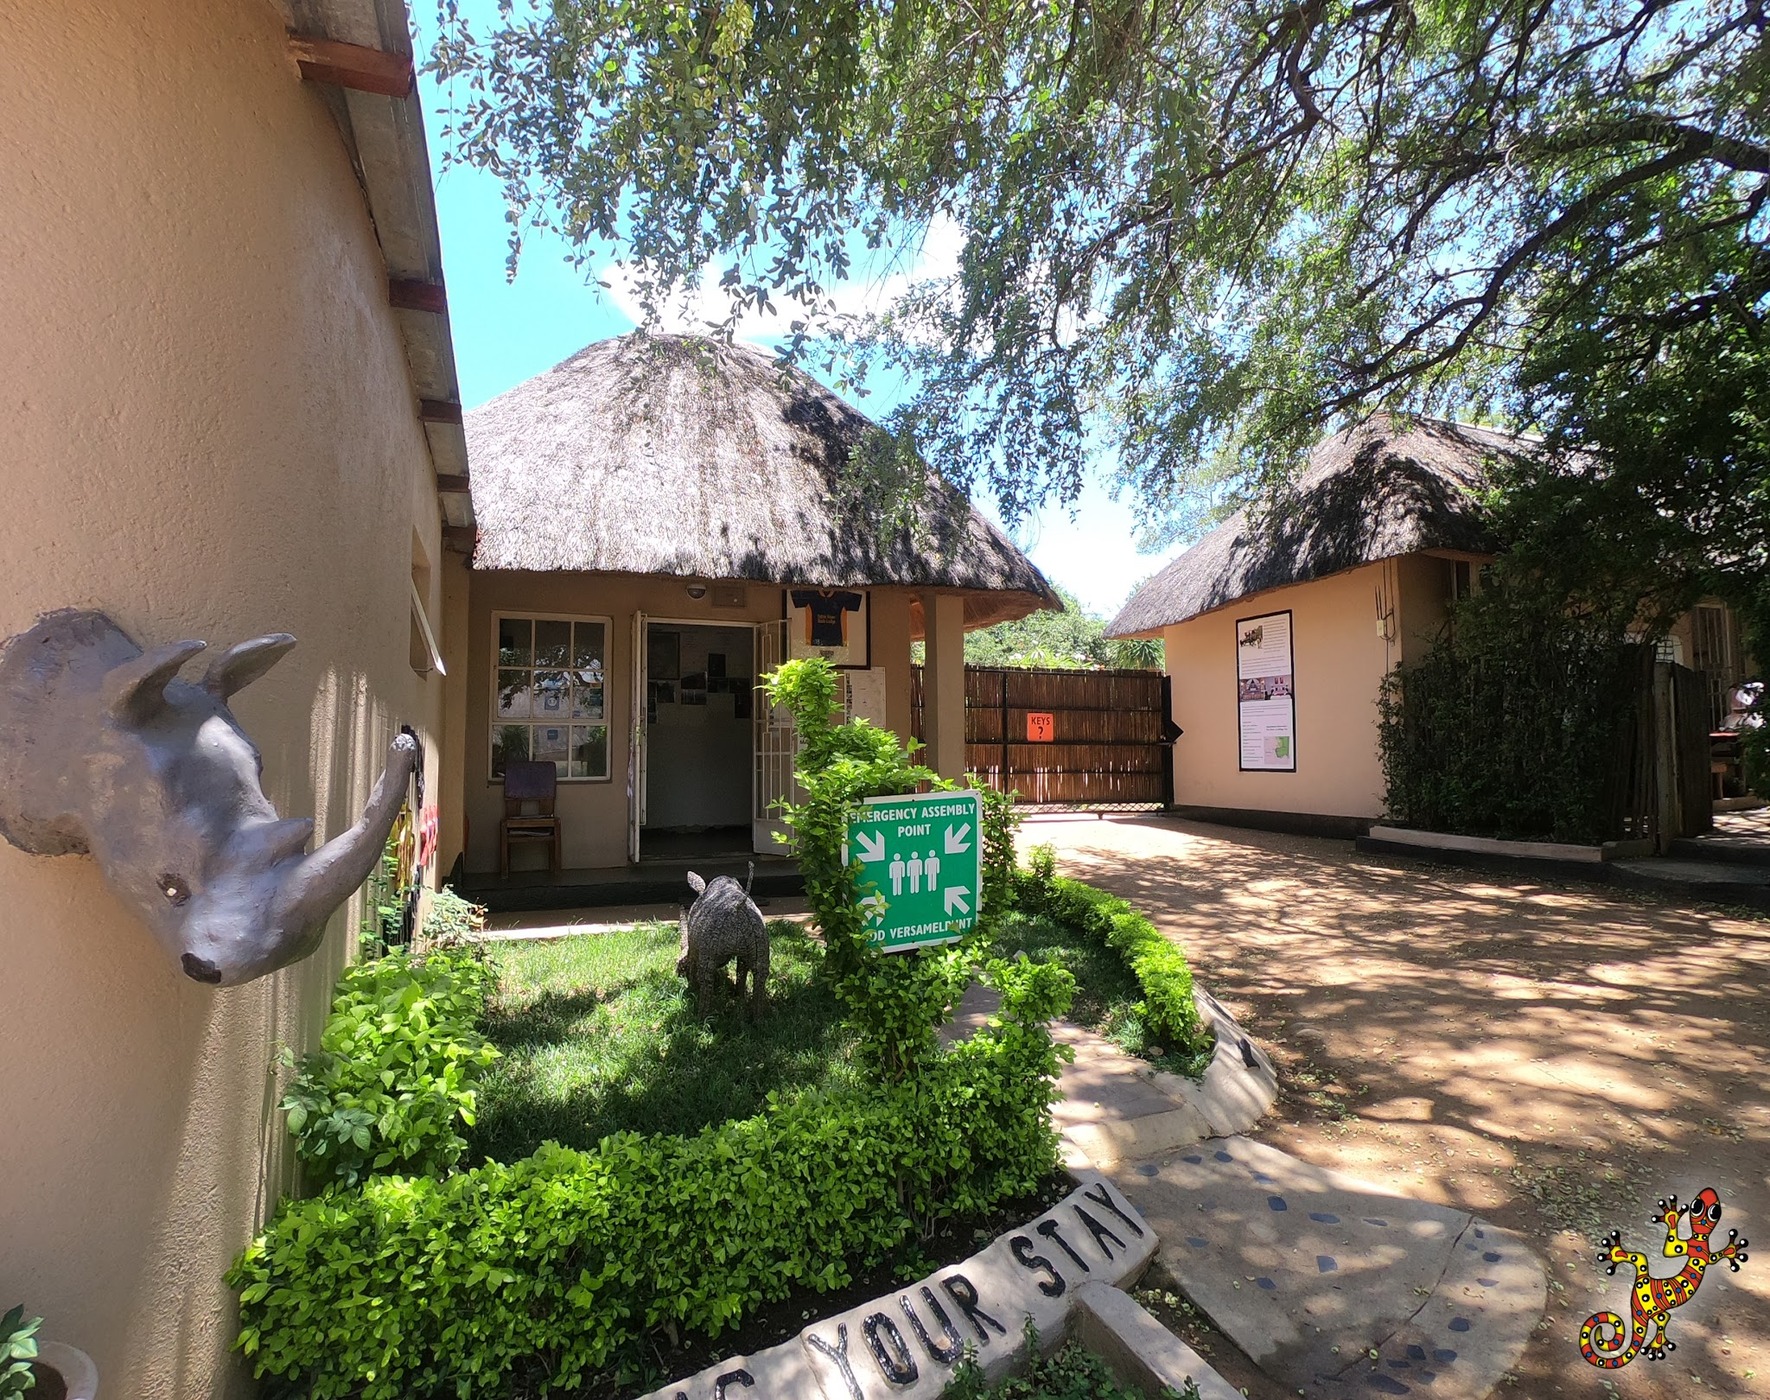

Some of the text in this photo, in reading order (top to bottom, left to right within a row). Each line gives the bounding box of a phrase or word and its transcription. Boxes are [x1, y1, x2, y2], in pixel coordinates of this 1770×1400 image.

[1031, 716, 1051, 726] KEYS
[921, 803, 975, 818] ASSEMBLY
[897, 823, 932, 838] POINT
[890, 917, 973, 940] VERSAMELPNT
[808, 1182, 1145, 1400] YOUR STAY
